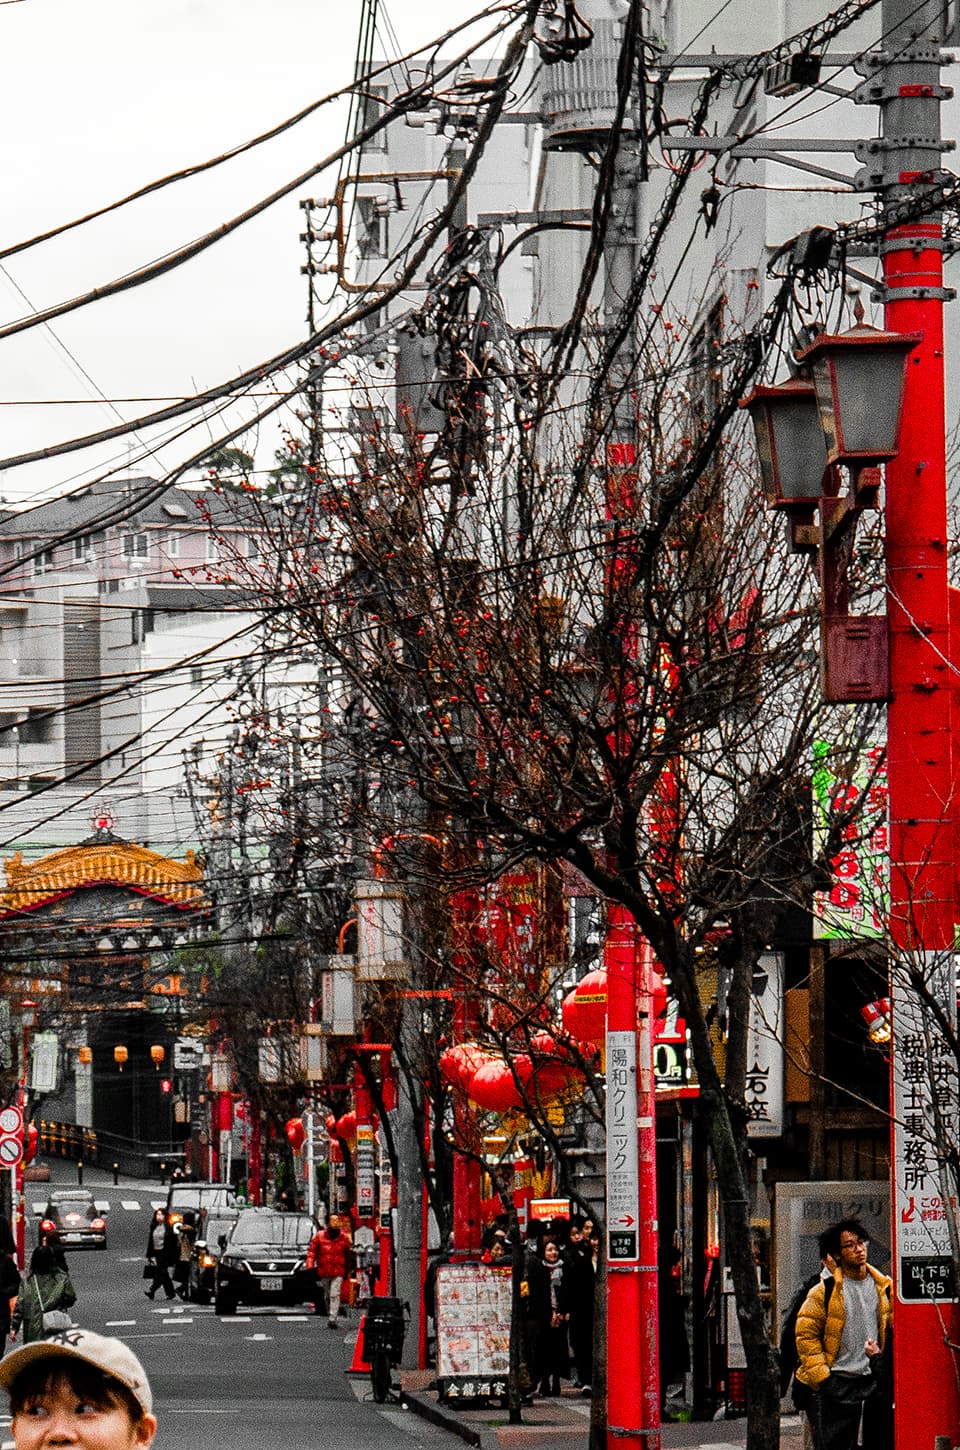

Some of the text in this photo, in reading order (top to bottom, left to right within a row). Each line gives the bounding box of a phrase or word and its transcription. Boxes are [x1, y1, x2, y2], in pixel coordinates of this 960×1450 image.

[610, 1048, 629, 1170] 陽和クリニック
[902, 1034, 927, 1191] 税理士事務所
